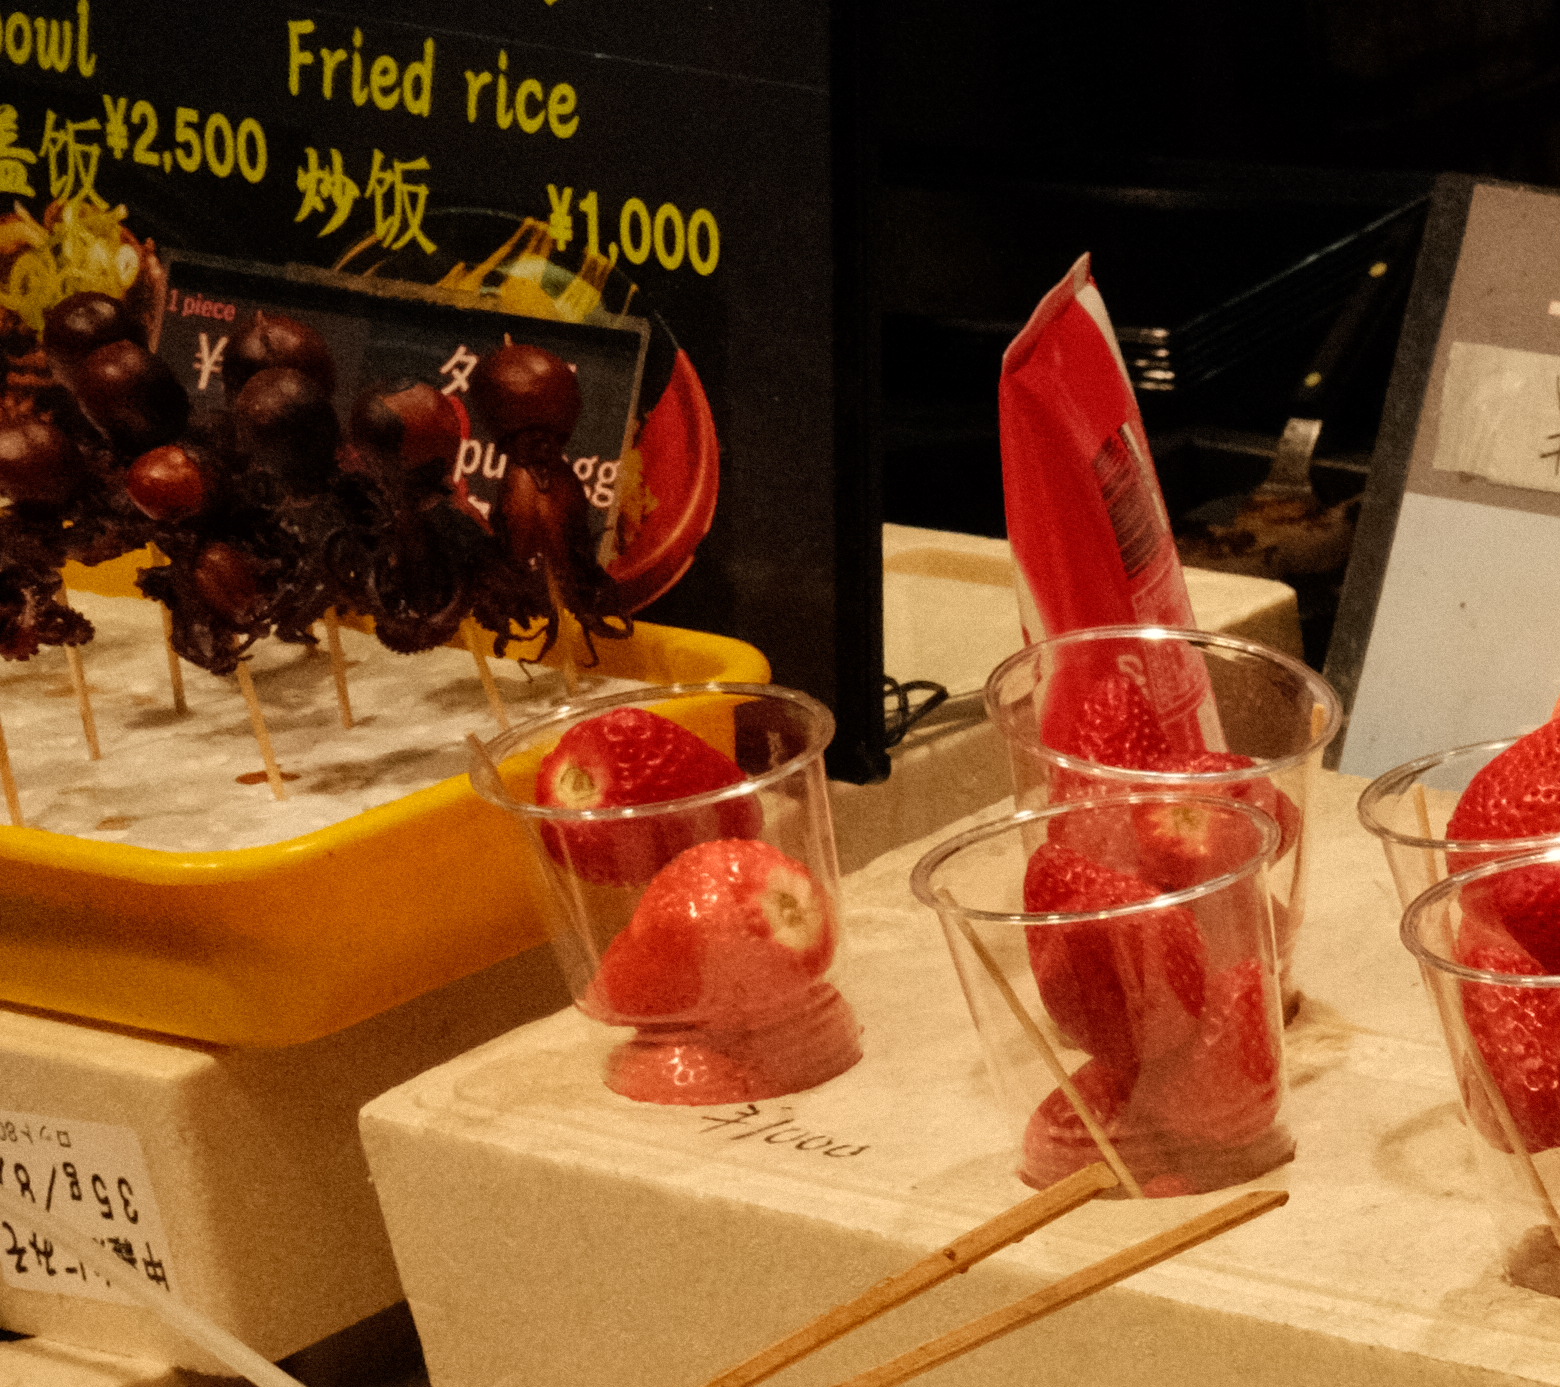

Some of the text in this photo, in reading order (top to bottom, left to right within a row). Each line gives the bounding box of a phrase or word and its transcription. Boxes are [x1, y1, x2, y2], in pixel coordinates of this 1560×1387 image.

[0, 0, 97, 78] owl
[288, 19, 580, 139] Fried rice
[103, 94, 269, 184] ¥2,500
[294, 147, 437, 254] 炒饭
[547, 184, 721, 276] ¥1,000
[182, 293, 237, 322] piece
[562, 453, 622, 509] gg
